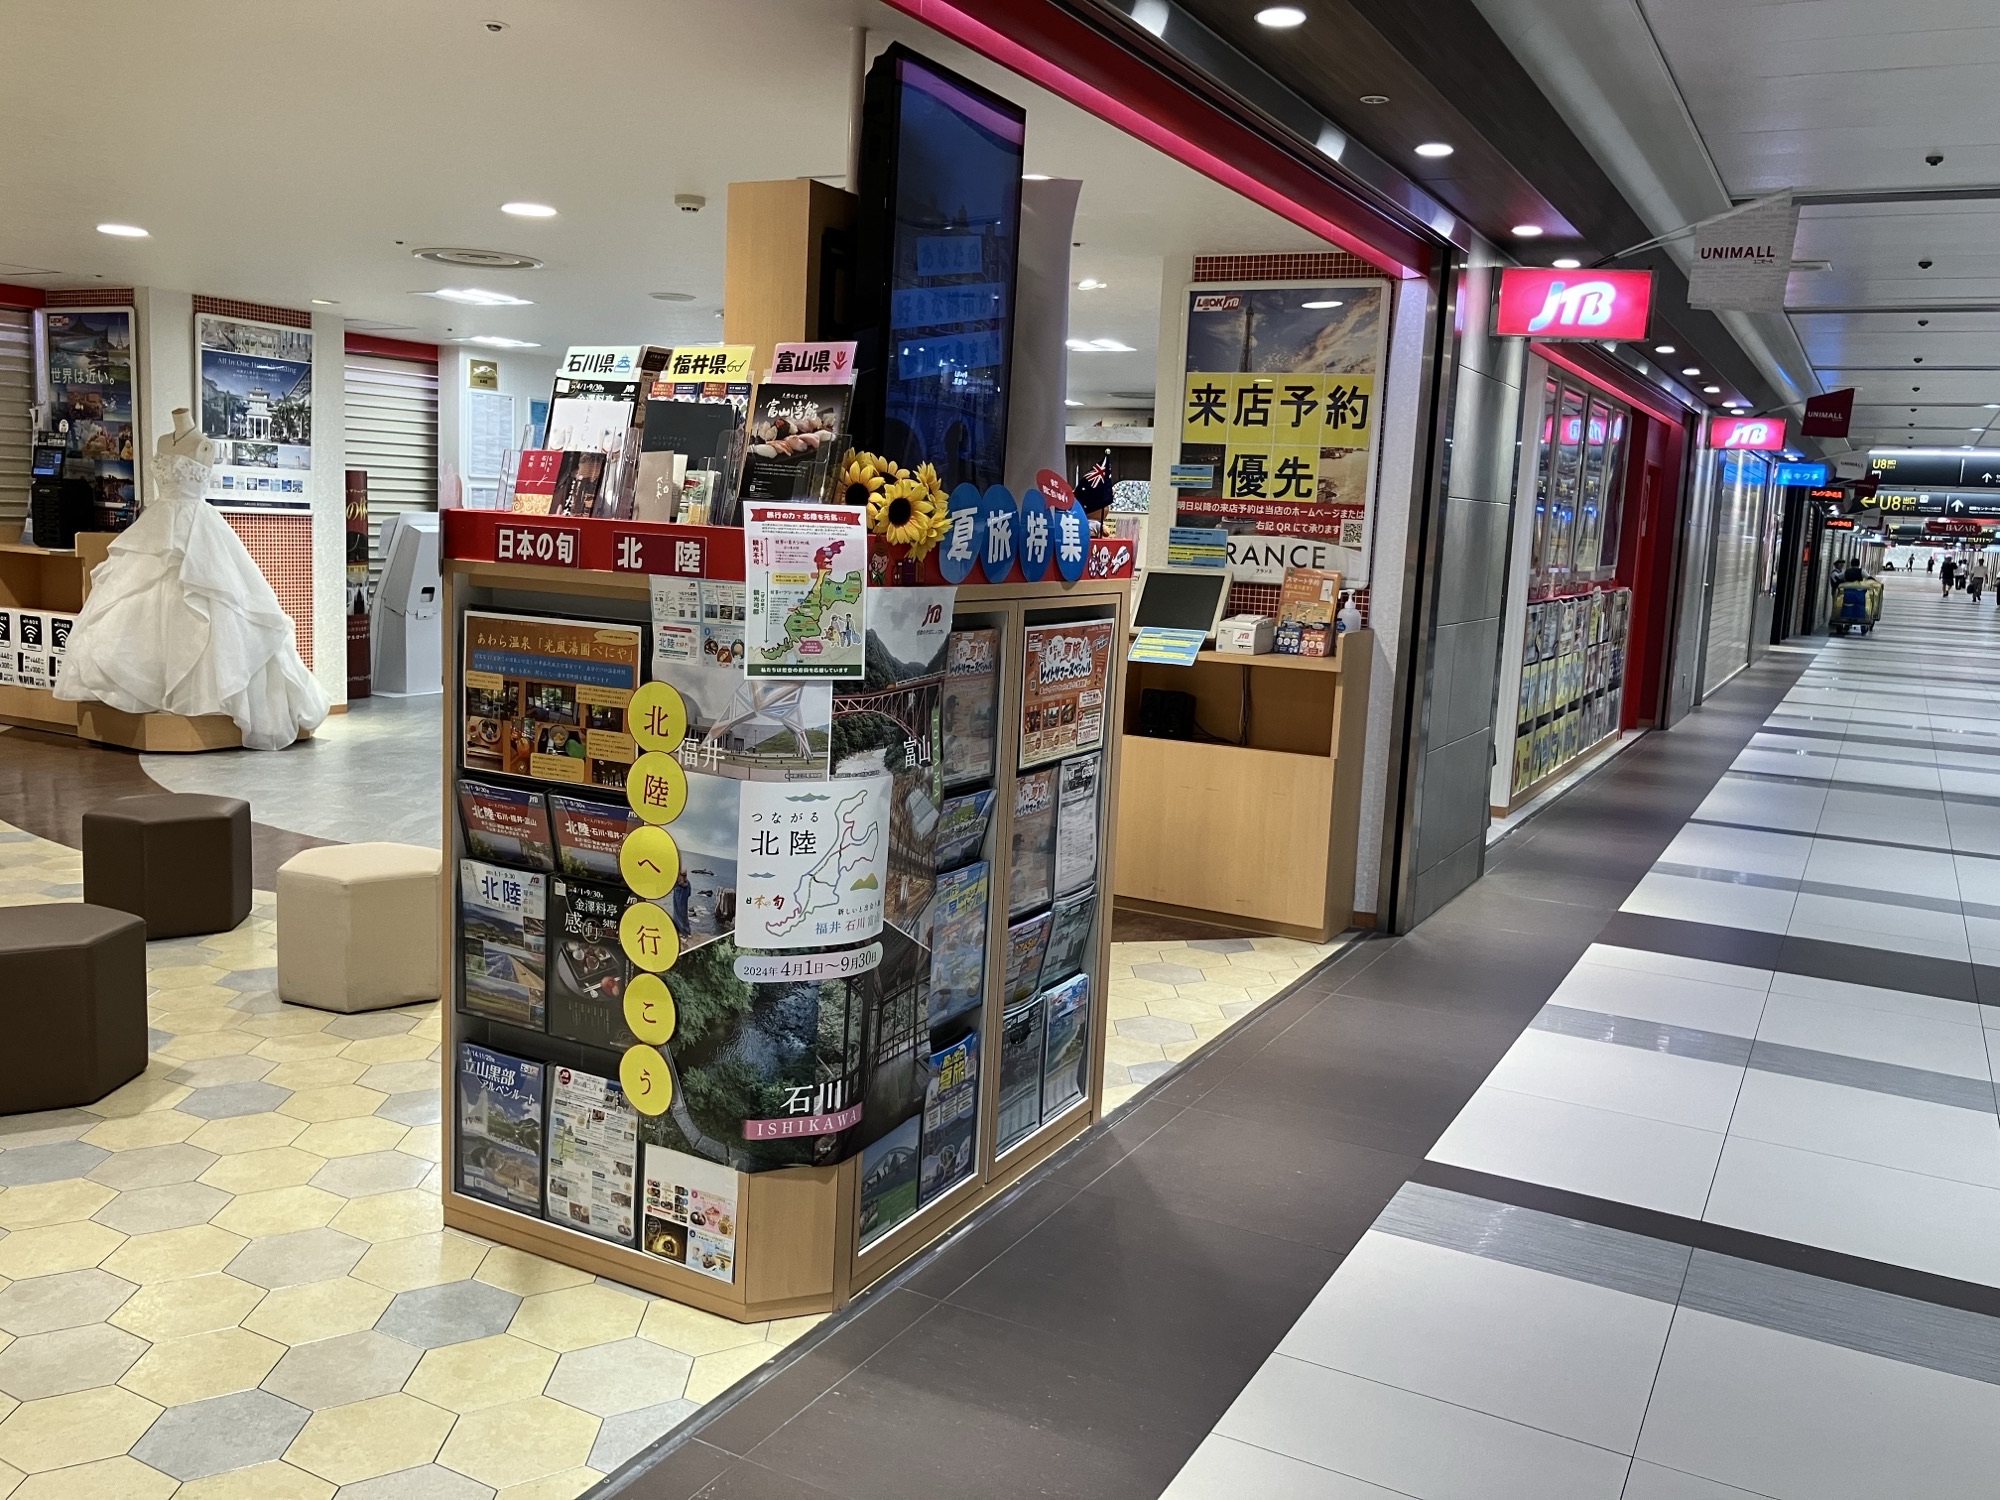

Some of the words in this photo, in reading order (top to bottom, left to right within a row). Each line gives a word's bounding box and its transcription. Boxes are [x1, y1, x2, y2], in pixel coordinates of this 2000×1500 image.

[1701, 246, 1775, 259] UNIMALL
[1528, 281, 1617, 331] JTB
[567, 353, 615, 373] 石川県
[672, 353, 727, 374] 福井県
[775, 350, 831, 373] 富山県
[51, 367, 115, 386] 世界は近い。
[1188, 383, 1370, 431] 来店予約
[1808, 411, 1843, 420] UNIMALL
[1725, 423, 1767, 446] JTB
[1872, 459, 1887, 469] U8
[1226, 453, 1317, 499] 優先
[1178, 501, 1365, 519] 明日以降の来店予約は当店のホームページまたは
[1880, 495, 1901, 510] U8
[1902, 496, 1916, 504] 出口
[946, 507, 1082, 564] 夏旅特集
[1255, 521, 1275, 531] 右記
[1277, 523, 1292, 533] QR
[1293, 523, 1340, 535] にて承ります
[1945, 524, 1976, 532] BAZAR
[498, 528, 575, 564] 日本の旬
[617, 536, 701, 573] 北陸
[921, 604, 942, 627] JTB
[1237, 632, 1249, 640] JTB
[677, 737, 726, 771] 福井
[902, 735, 931, 768] 富山
[751, 812, 819, 824] つながる
[751, 829, 817, 857] 北陸
[481, 875, 522, 907] 北陸
[746, 894, 785, 911] 日本の旬
[575, 898, 618, 917] 金澤料亭
[815, 921, 842, 935] 福井
[845, 917, 865, 932] 石川
[462, 1058, 516, 1086] 立山黒部
[780, 1080, 842, 1114] 石川
[756, 1109, 858, 1137] ISHIKAWA
